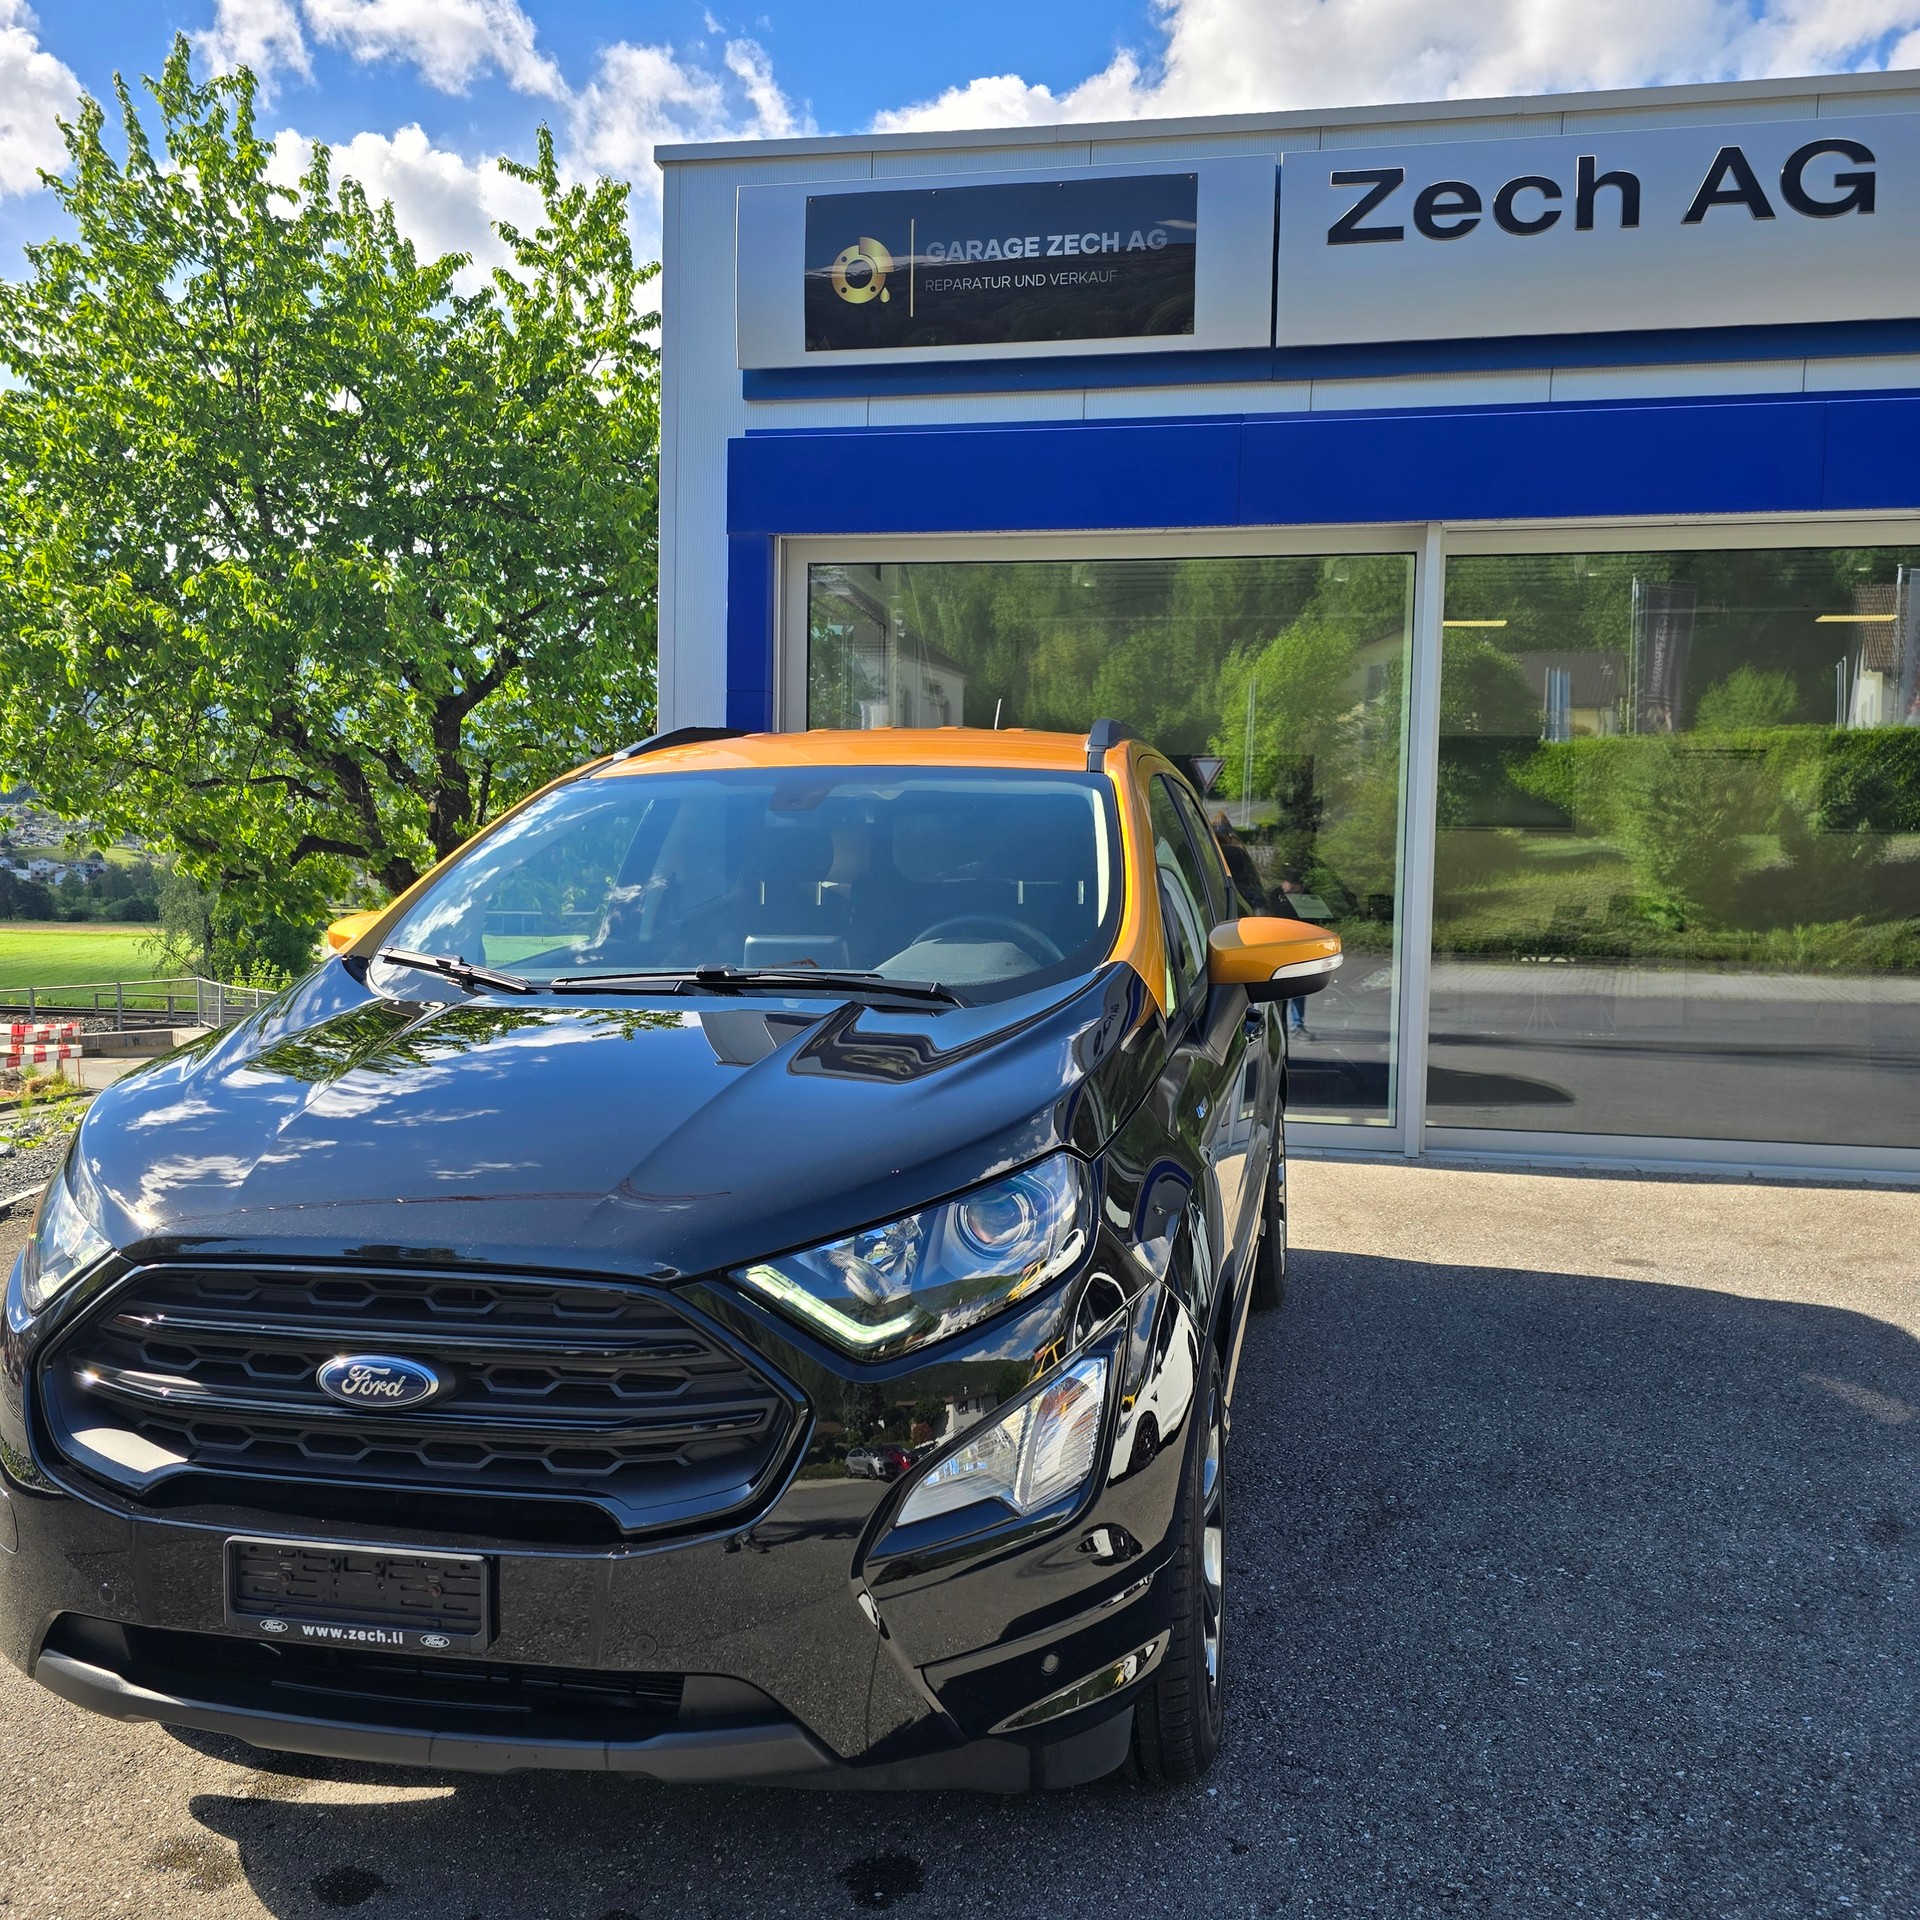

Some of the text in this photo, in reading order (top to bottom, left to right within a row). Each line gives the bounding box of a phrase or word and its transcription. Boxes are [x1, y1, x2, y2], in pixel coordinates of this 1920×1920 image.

[1326, 137, 1877, 246] Zech AG
[926, 228, 1168, 263] GARAGE ZECH AG
[925, 269, 1118, 292] REPARATUR UND VERKAUF
[341, 1365, 406, 1397] Ford
[264, 1620, 284, 1631] Ford
[302, 1624, 403, 1644] www.zech.li
[424, 1636, 446, 1647] Ford
